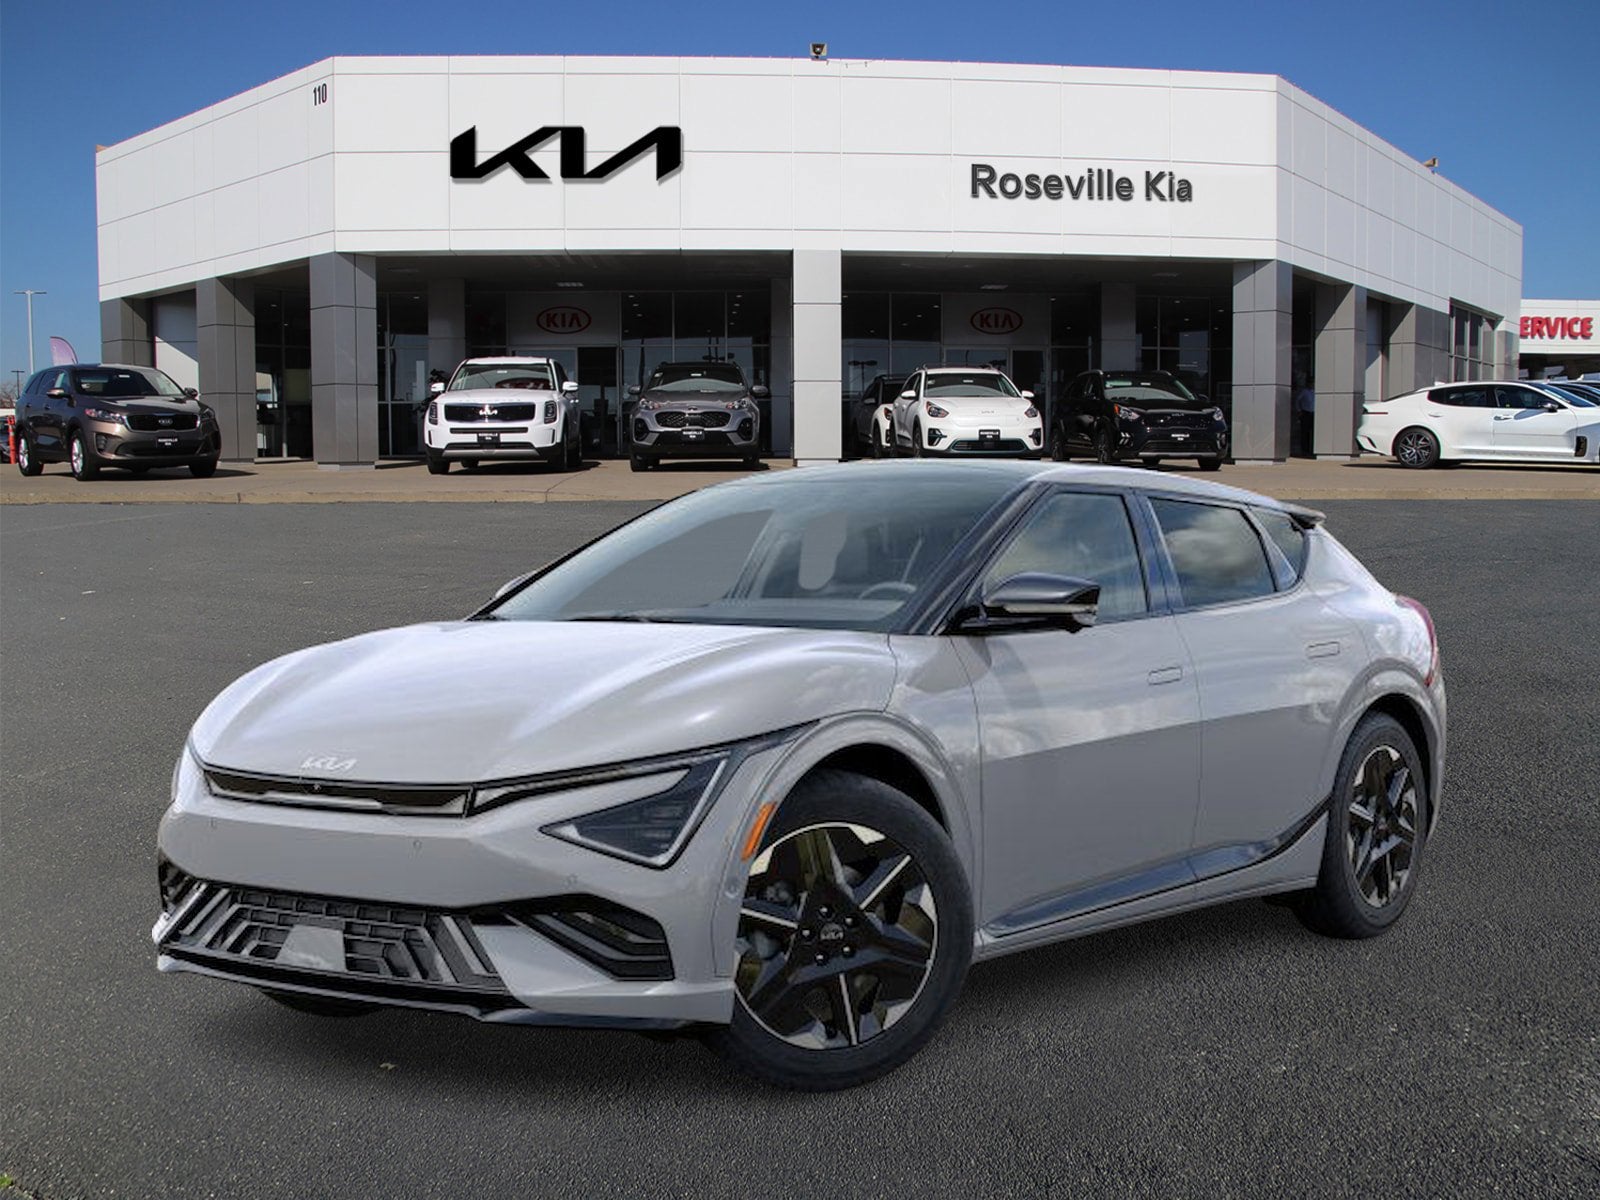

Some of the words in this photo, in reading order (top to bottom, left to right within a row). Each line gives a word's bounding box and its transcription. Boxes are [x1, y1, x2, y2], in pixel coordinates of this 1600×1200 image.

[313, 83, 327, 106] 110
[971, 163, 1135, 202] Roseville
[1145, 170, 1193, 203] Kia
[545, 312, 582, 328] KIA
[979, 312, 1014, 329] KIA
[1520, 316, 1594, 339] ERVICE
